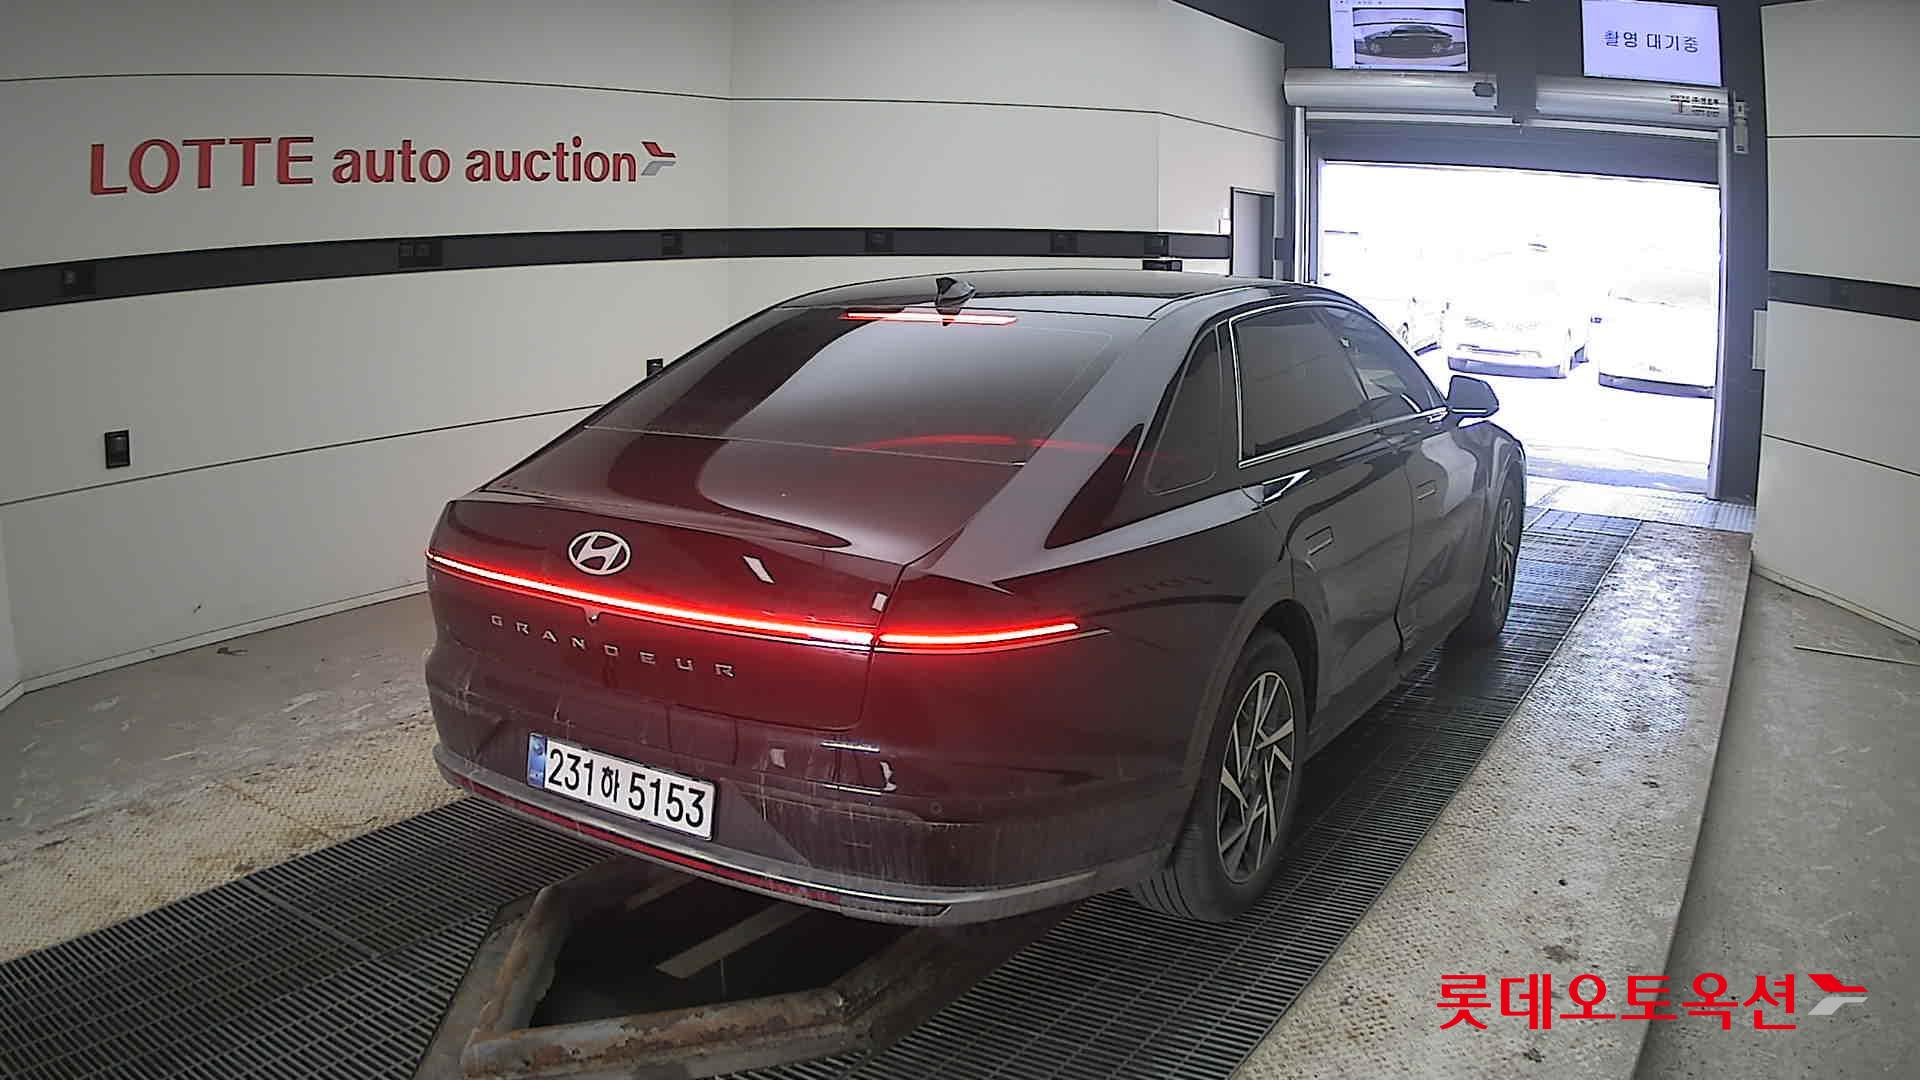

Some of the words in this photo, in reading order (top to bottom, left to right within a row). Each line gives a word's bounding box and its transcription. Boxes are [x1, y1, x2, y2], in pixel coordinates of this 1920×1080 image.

[1646, 33, 1699, 53] 대기중
[90, 136, 314, 195] LOTTE
[331, 139, 451, 184] auto
[464, 136, 637, 183] auction
[491, 614, 736, 678] GRANDEUR
[628, 771, 707, 829] 5153
